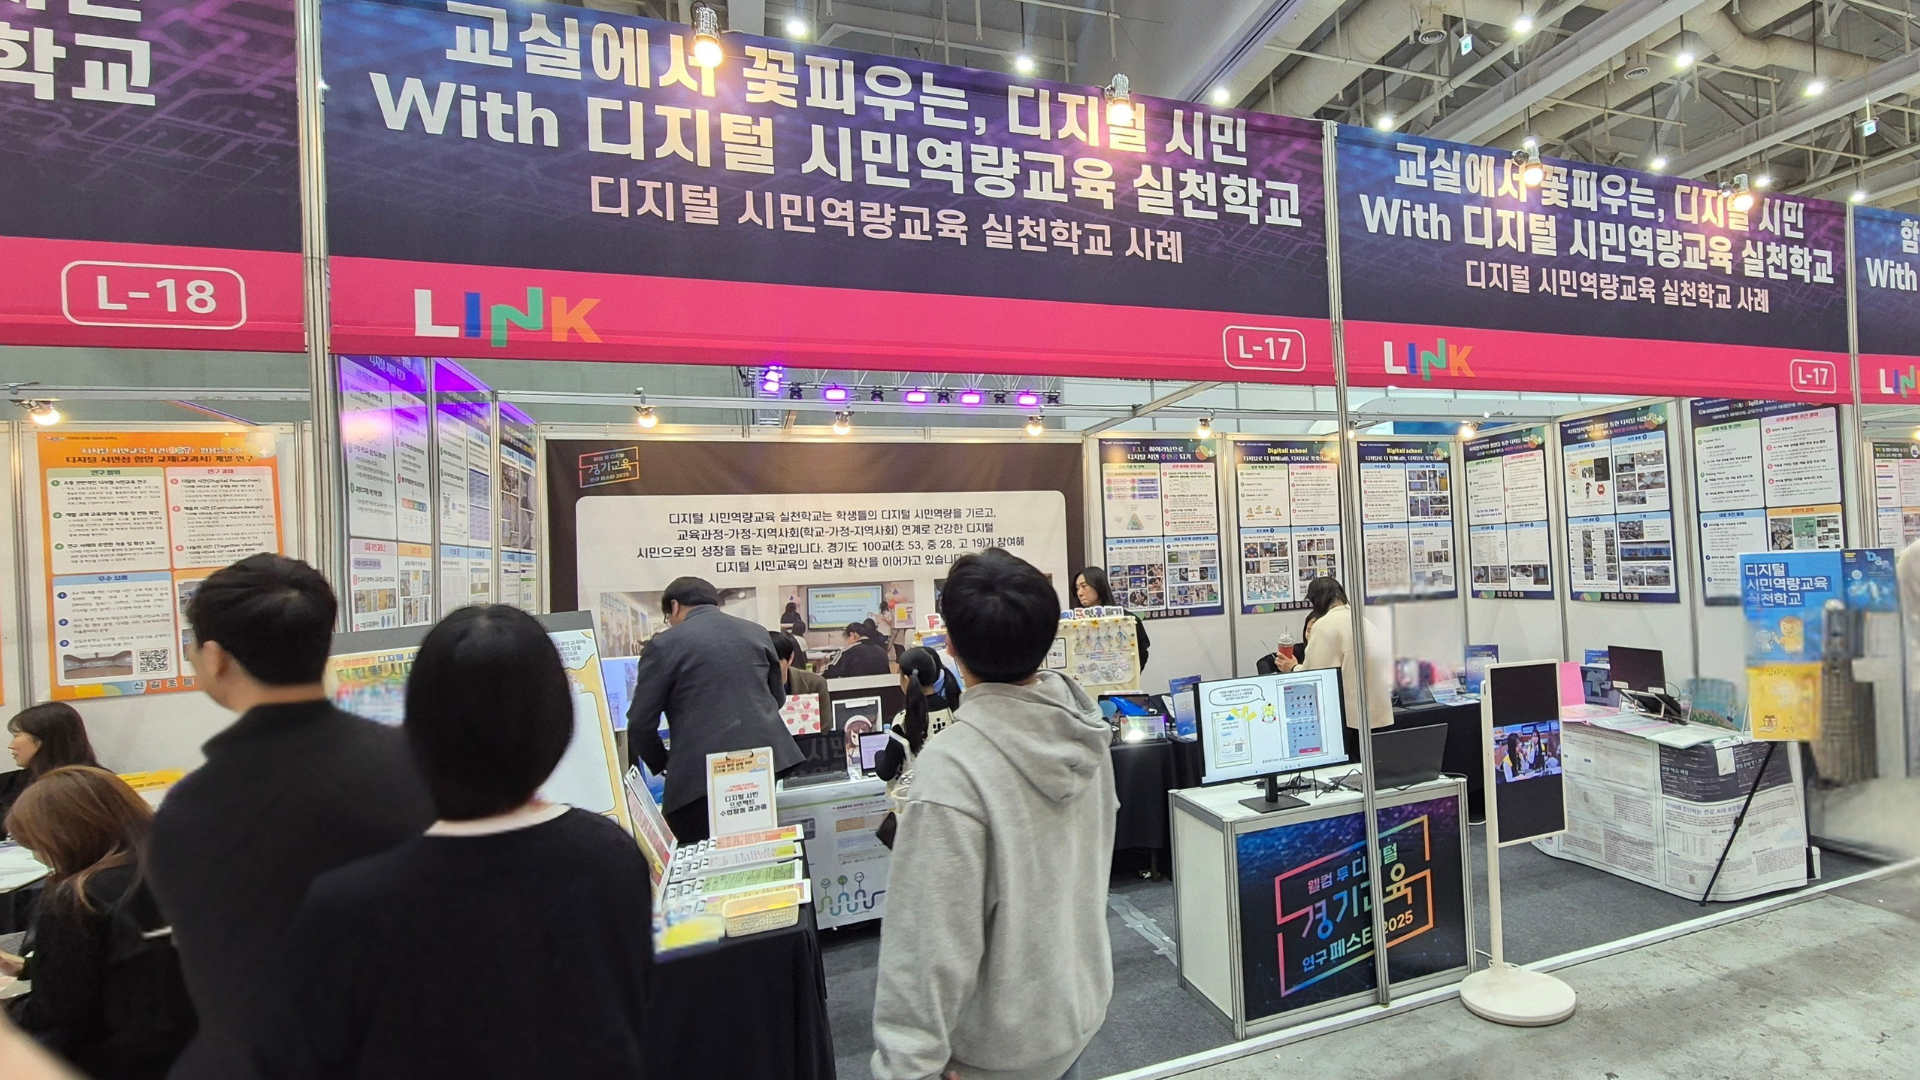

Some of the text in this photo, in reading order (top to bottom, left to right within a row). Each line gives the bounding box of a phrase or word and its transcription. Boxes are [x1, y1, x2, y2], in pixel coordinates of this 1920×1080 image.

[0, 29, 156, 106] 학교
[445, 1, 1248, 166] 교실에서 꽃피우는, 디지털 시민
[369, 72, 1302, 227] With 디지털 시민역량교육 실천학교
[1395, 142, 1805, 241] 교실에서 꽃피우는, 디지털 시민
[590, 176, 1184, 265] 디지털 시민역량교육 실천학교 사례
[1360, 194, 1835, 286] With 디지털 시민역량교육 실천학교
[1466, 260, 1770, 315] 디지털 시민역량교육 실천학교 사례
[1865, 257, 1917, 291] With
[97, 275, 217, 315] L-18
[414, 286, 604, 348] LINK
[1238, 335, 1292, 362] L-17
[1383, 338, 1477, 381] LINK
[1798, 367, 1829, 387] L-17
[1879, 365, 1920, 398] LIN
[588, 458, 631, 475] 경기교육
[668, 507, 996, 524] 디지털 시민역량교육 실천학교는 학생들의 디지털 시민역량을 기르고,
[901, 524, 931, 536] 연계로
[934, 523, 963, 535] 건강한
[966, 523, 993, 534] 디지털
[636, 536, 1025, 559] 시민으로의 성장을 돕는 학교입니다. 경기도 100교(초 53, 중 28, 고 19)가 참여해
[716, 561, 749, 573] 디지털
[754, 560, 808, 572] 시민교육의
[812, 558, 843, 570] 실천과
[847, 556, 878, 568] 확산을
[882, 555, 921, 567] 이어가고
[1745, 563, 1786, 577] 디지털
[1746, 576, 1829, 592] 시민역량교육
[725, 791, 759, 802] 디지털 시민
[1307, 843, 1398, 895] 웰컴 투 디털
[1302, 948, 1328, 973] 연구
[1383, 909, 1414, 935] 2025
